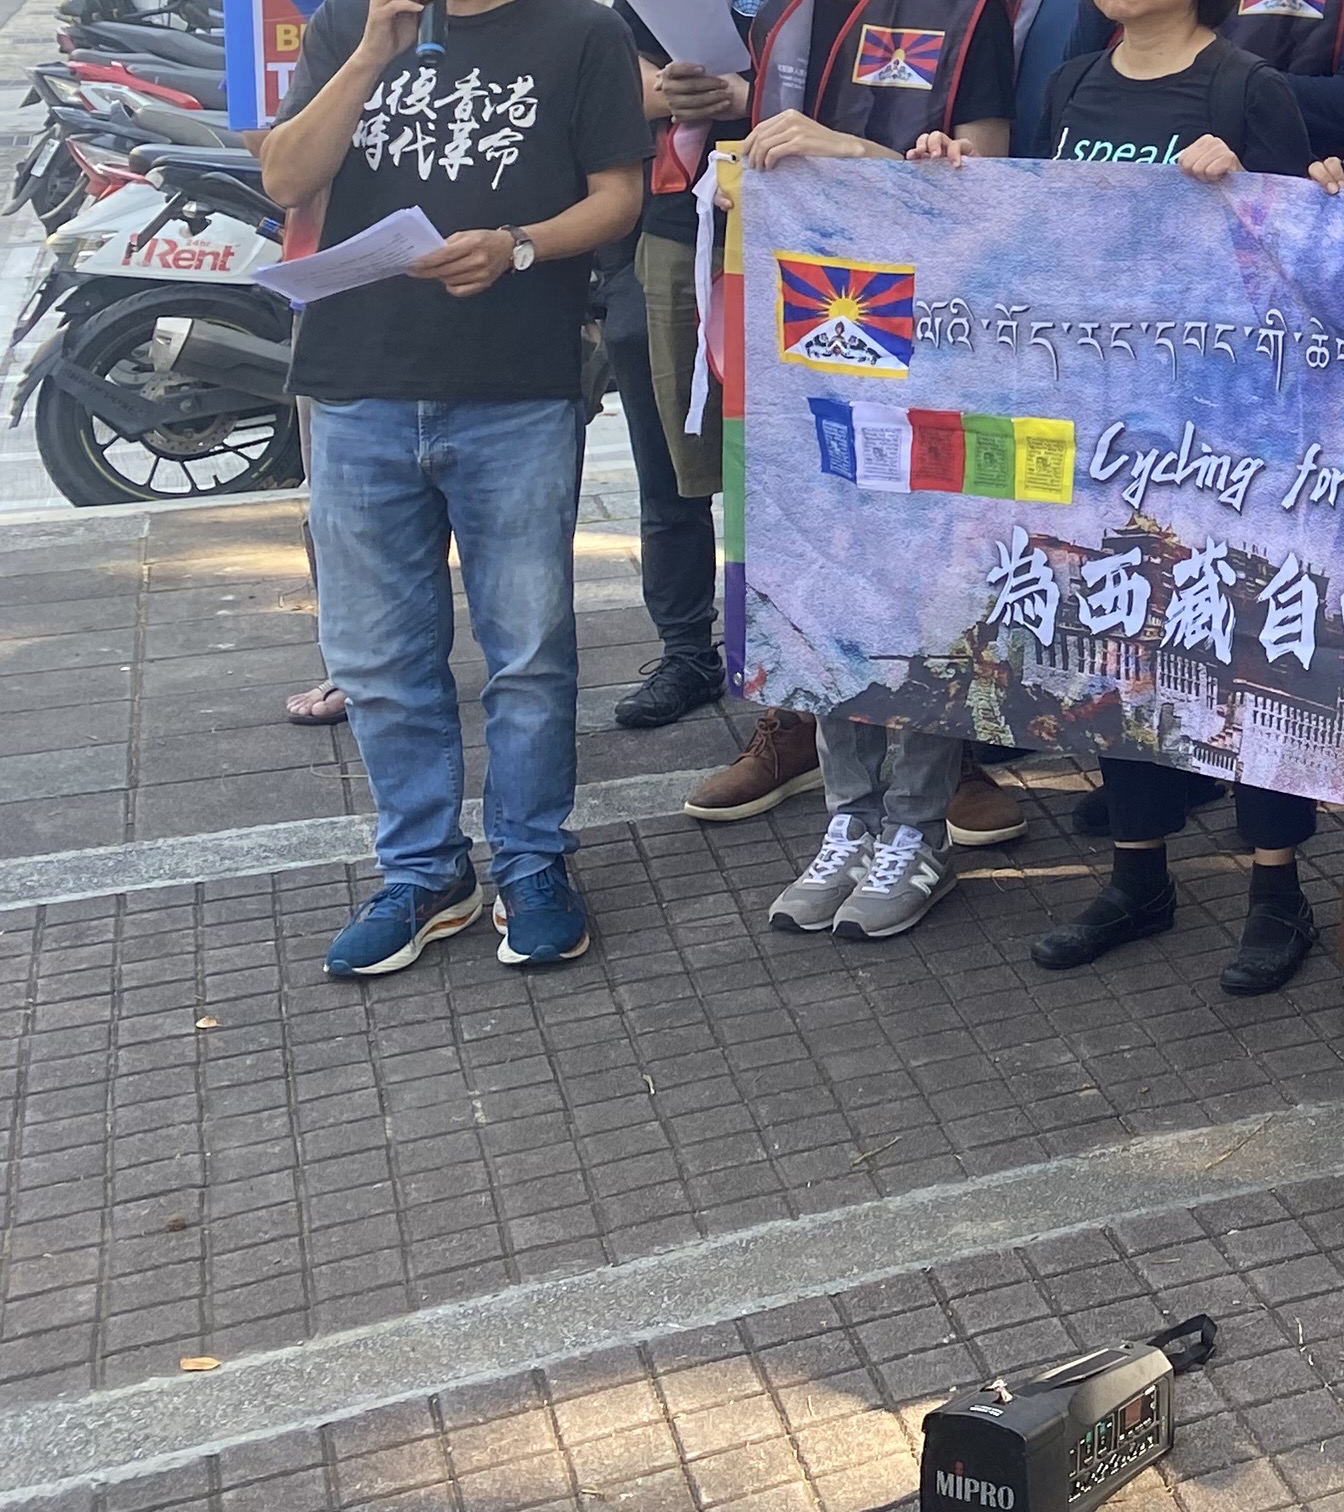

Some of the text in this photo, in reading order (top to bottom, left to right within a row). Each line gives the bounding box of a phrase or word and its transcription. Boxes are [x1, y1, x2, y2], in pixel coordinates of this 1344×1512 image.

[364, 66, 538, 127] 復香港
[1088, 419, 1266, 512] Cycling
